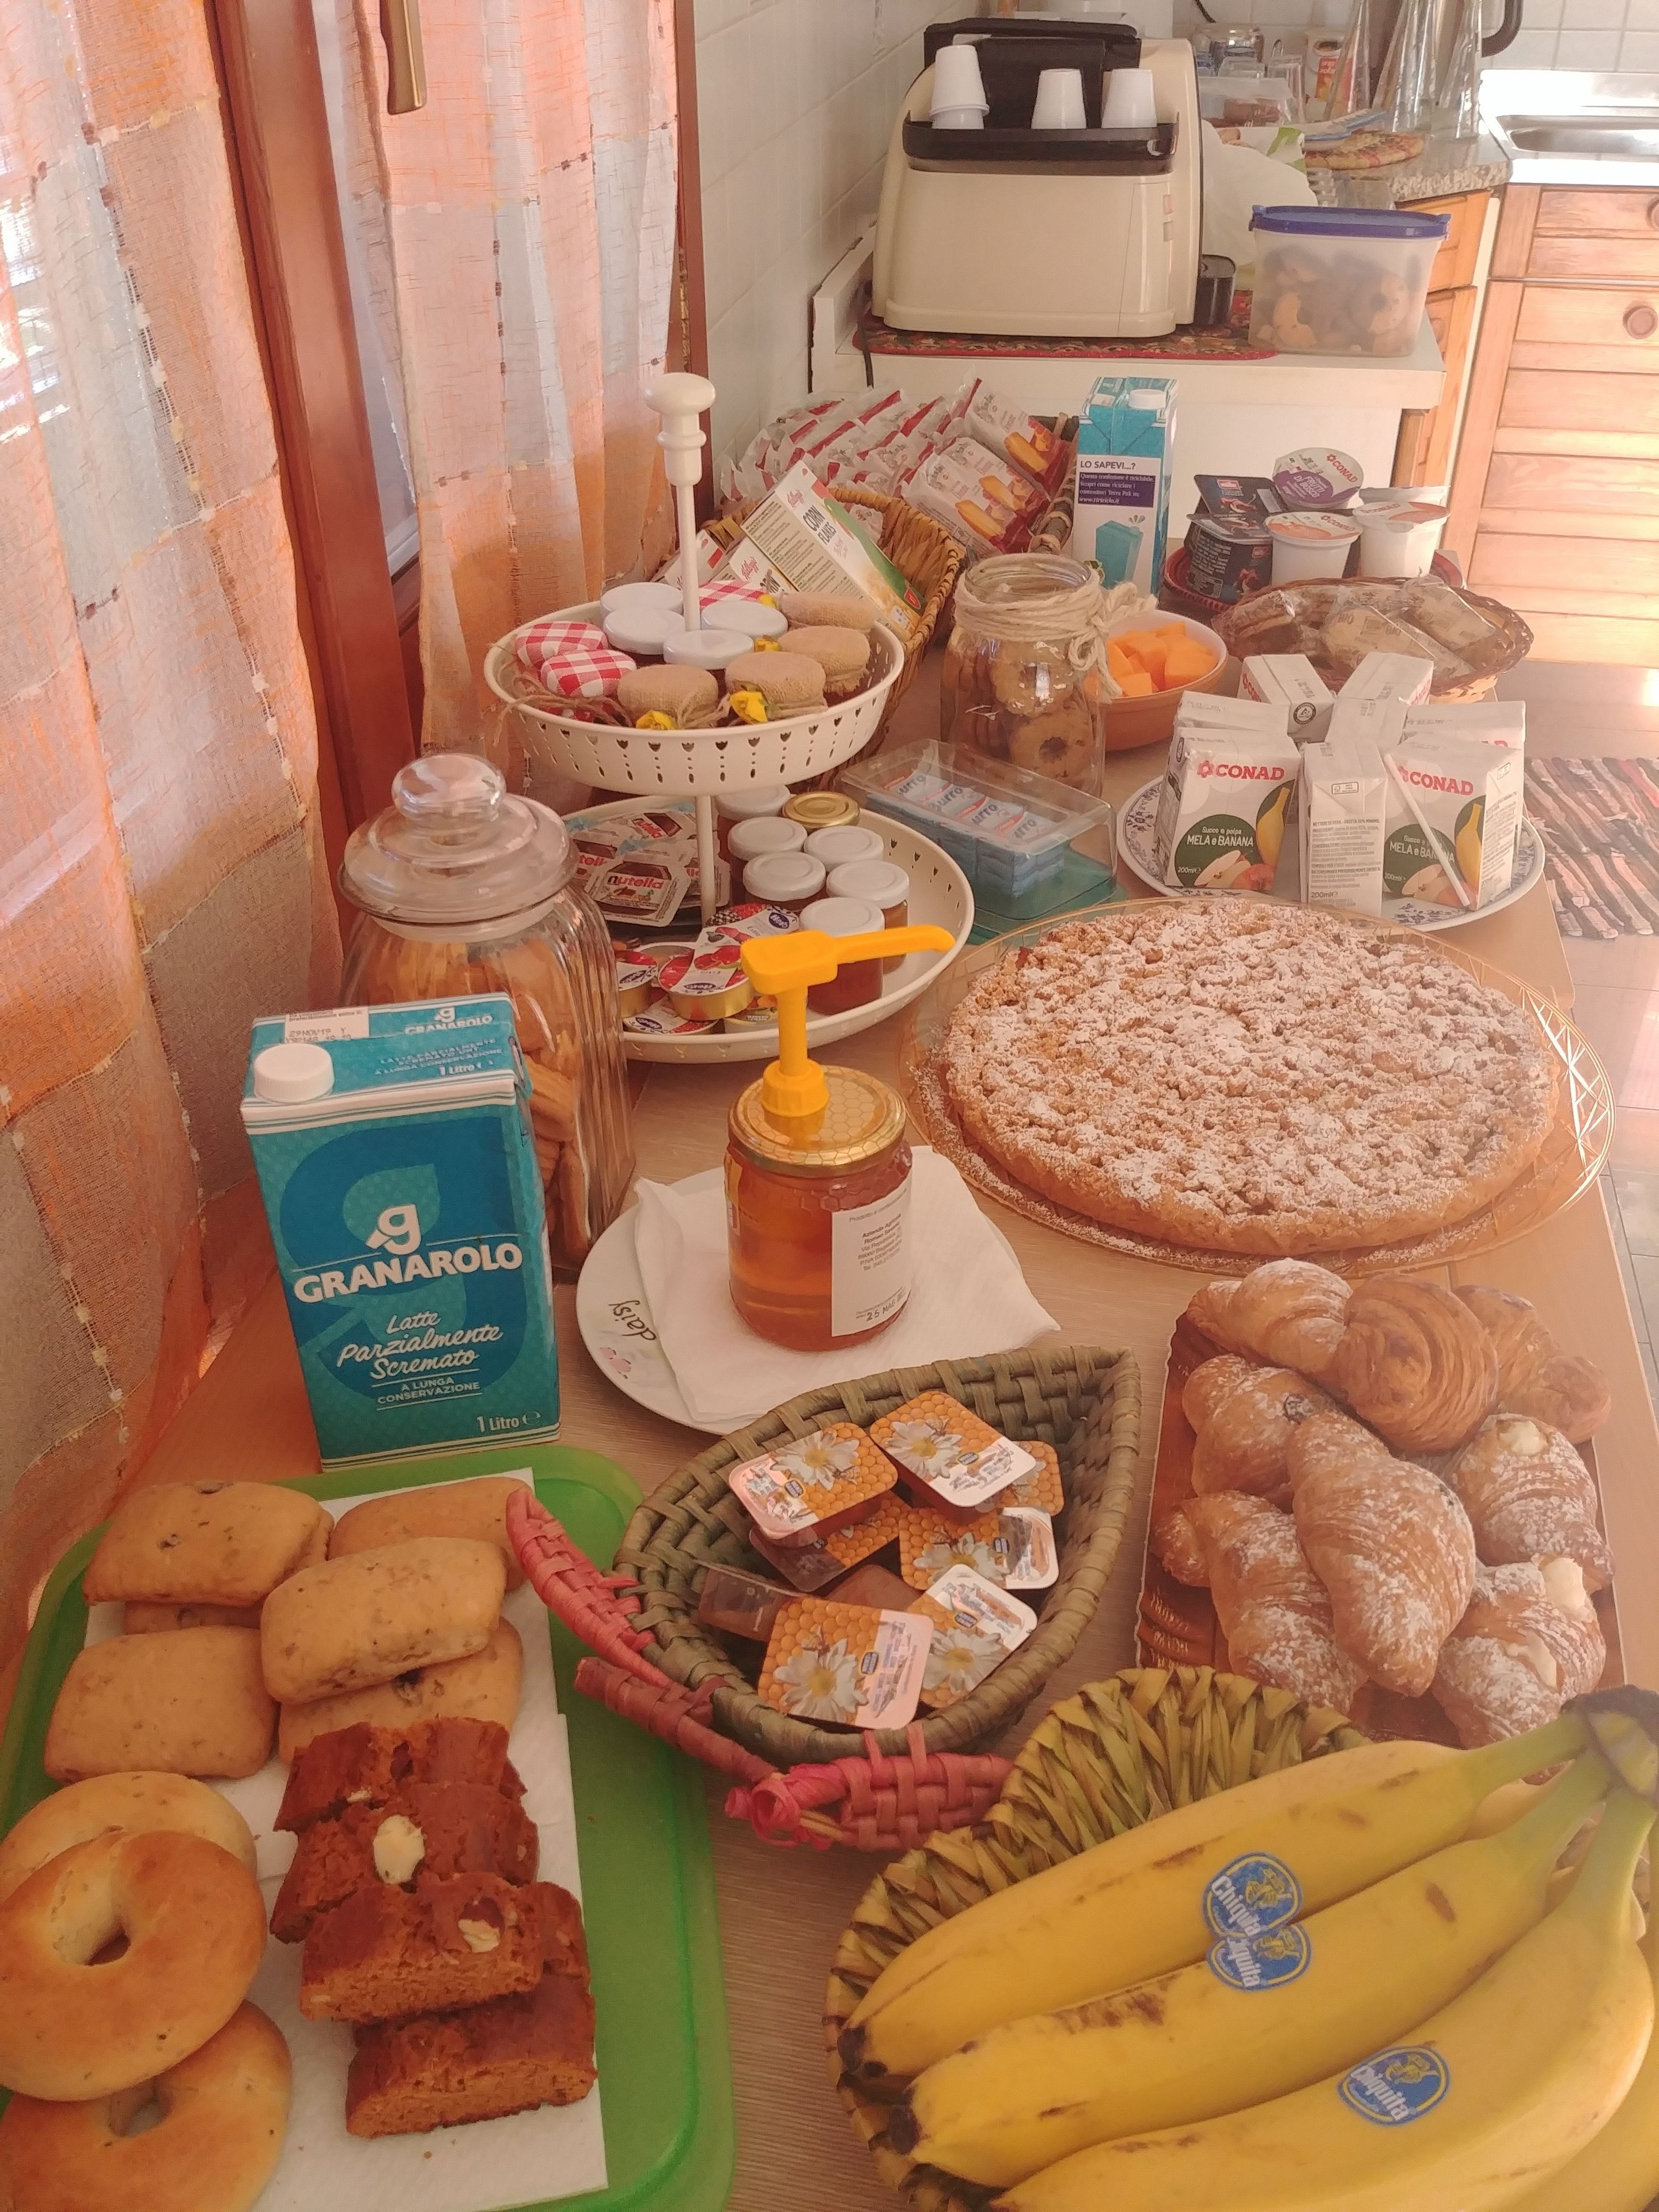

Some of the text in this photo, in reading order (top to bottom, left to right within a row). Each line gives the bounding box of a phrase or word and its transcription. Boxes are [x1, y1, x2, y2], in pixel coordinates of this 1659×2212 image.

[1080, 460, 1136, 470] LO SAPEVI...?
[1332, 460, 1358, 483] CONAD
[1299, 482, 1320, 498] BOSCO
[1304, 475, 1325, 493] FRUTTI
[802, 505, 825, 532] CORN
[817, 521, 838, 546] FLAKES
[1215, 764, 1285, 781] CONAD
[1410, 771, 1475, 796] CONAD
[1187, 835, 1210, 846] MELA
[1217, 836, 1254, 847] BANANA
[1226, 828, 1242, 836] polpa
[1403, 835, 1421, 844] Succo
[1389, 840, 1412, 854] MELA
[1414, 847, 1419, 855] e
[607, 875, 664, 890] nutella
[771, 913, 789, 929] Hero
[404, 1014, 494, 1035] GRANAROLO
[439, 1064, 475, 1076] 1 Litro
[293, 1242, 524, 1304] GRANAROLO
[385, 1310, 442, 1335] Latte
[608, 1300, 657, 1341] daisy
[336, 1323, 505, 1368] Parzialmente
[369, 1349, 480, 1380] Scremato
[377, 1381, 481, 1404] CONSERVAZIONE
[401, 1376, 455, 1392] A LUNGA
[476, 1415, 520, 1433] 1 Litro
